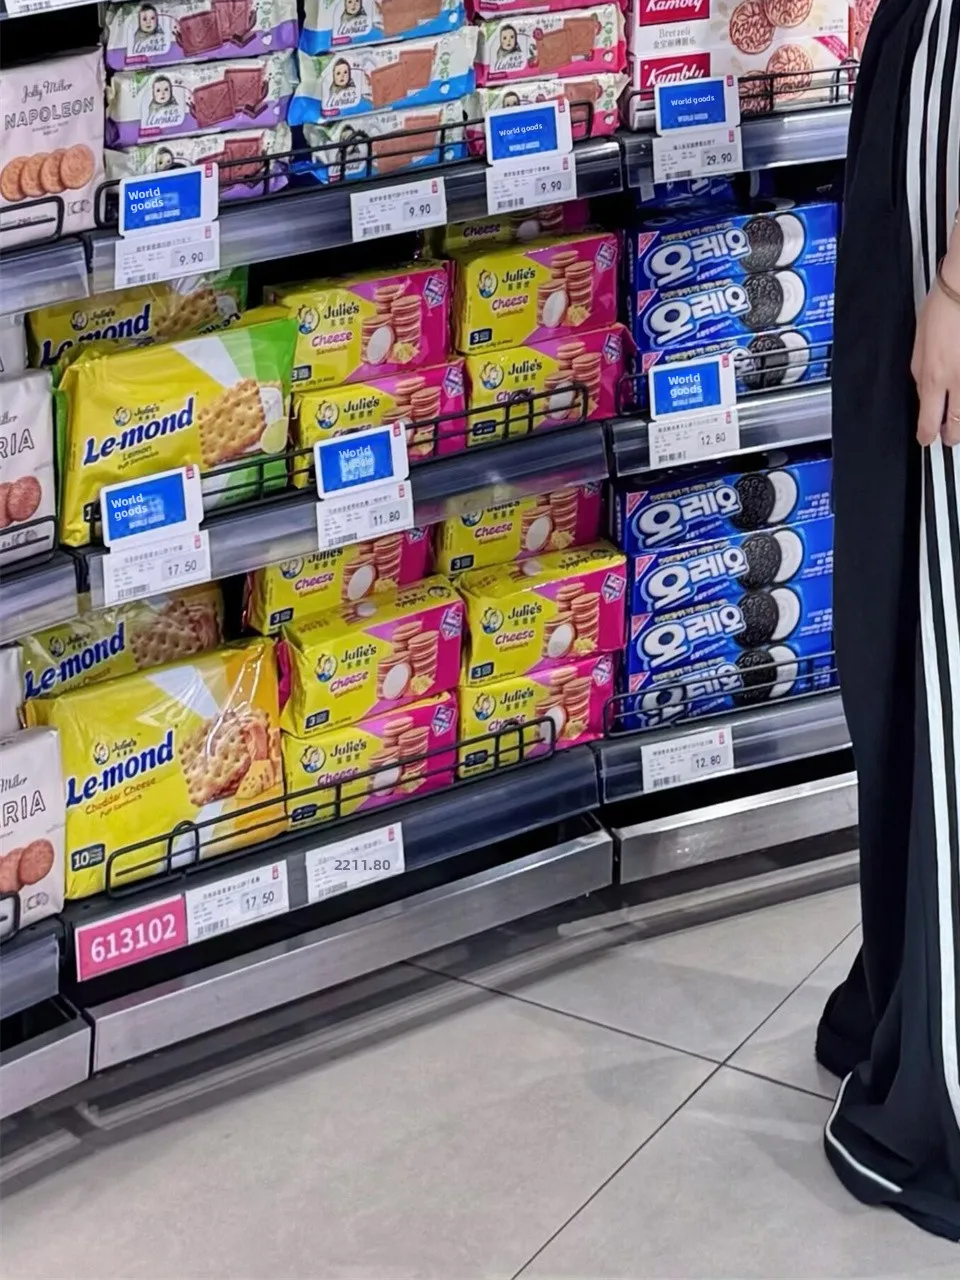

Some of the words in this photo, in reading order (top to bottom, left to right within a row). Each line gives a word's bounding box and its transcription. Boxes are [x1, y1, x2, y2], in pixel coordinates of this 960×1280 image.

[671, 97, 692, 106] World
[693, 95, 715, 105] goods
[4, 96, 95, 130] NAPOLEON
[706, 152, 732, 166] 29.90
[540, 181, 562, 192] 9.90
[179, 252, 204, 266] 9.90
[650, 228, 749, 286] 오레오
[502, 268, 536, 285] Julie's
[324, 302, 360, 320] Julie's
[491, 294, 529, 311] Cheese
[312, 331, 353, 347] Cheese
[668, 373, 701, 385] World
[670, 385, 703, 397] goods
[134, 402, 161, 418] Julie's
[83, 396, 195, 467] Le-mond
[339, 446, 371, 459] World
[112, 494, 143, 509] World
[115, 504, 148, 521] goods
[373, 510, 401, 525] 11.80
[639, 486, 738, 545] 오레오
[168, 560, 197, 576] 17.50
[507, 603, 542, 621] Julie's
[495, 629, 535, 646] Cheese
[341, 645, 377, 664] Julie's
[330, 671, 369, 693] Cheese
[66, 730, 175, 807] Le-mond
[695, 754, 721, 769] 12.80
[85, 786, 122, 816] Cheddar
[123, 774, 157, 797] Cheese
[2, 789, 47, 827] RIA
[74, 853, 89, 868] 10
[334, 858, 391, 872] 2211.80
[91, 914, 177, 964] 613102
